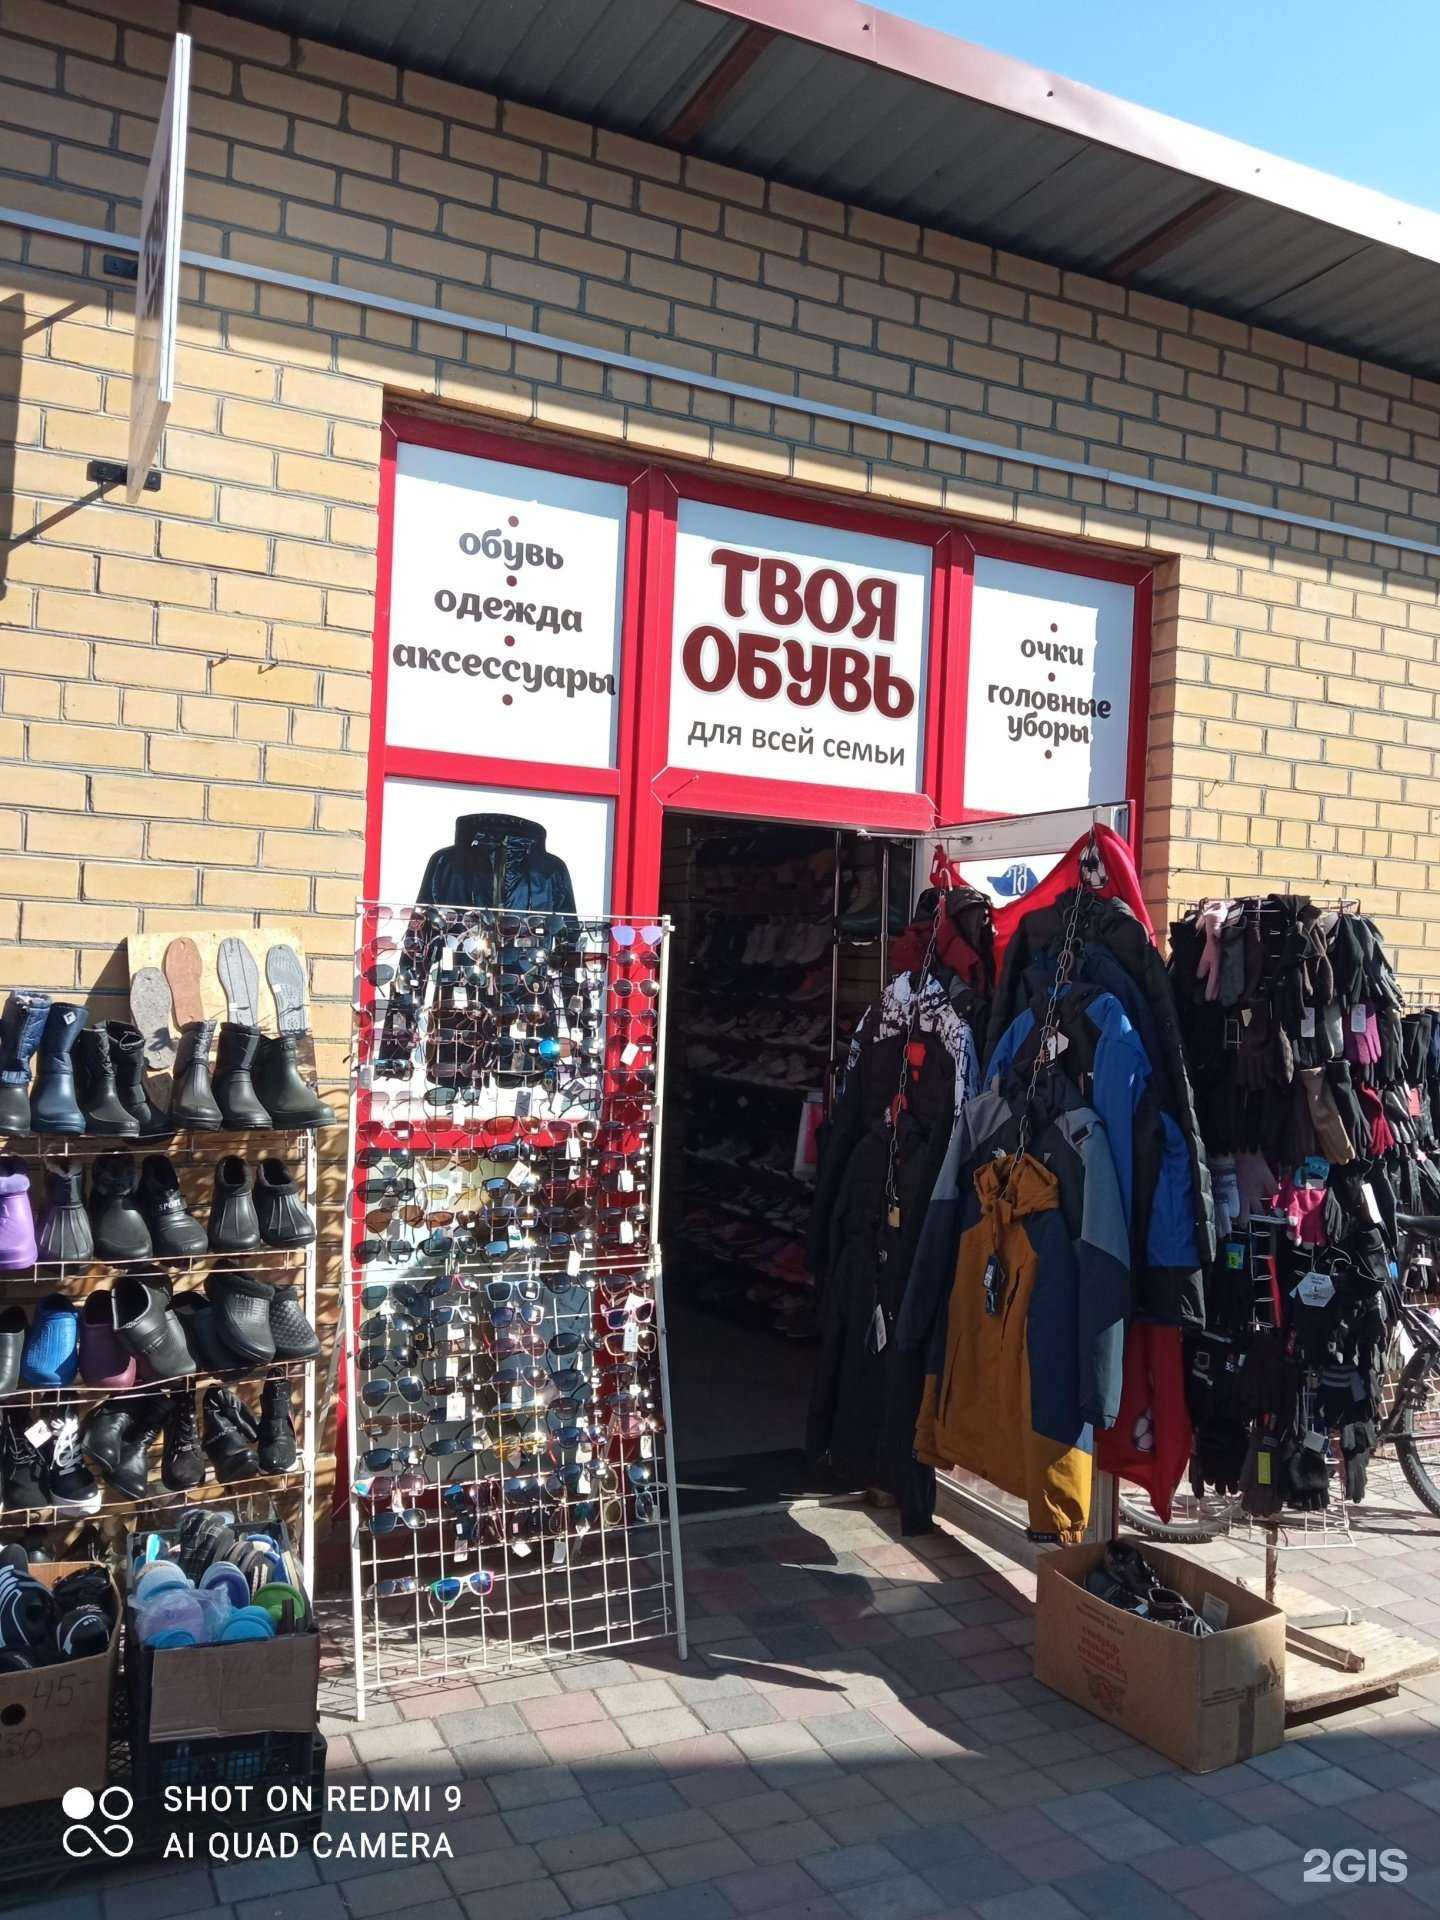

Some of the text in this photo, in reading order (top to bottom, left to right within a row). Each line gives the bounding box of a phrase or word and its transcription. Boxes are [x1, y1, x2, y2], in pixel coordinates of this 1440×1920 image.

[460, 529, 564, 571] обувь
[435, 588, 583, 633] одежда
[711, 548, 898, 643] ТВОЯ
[393, 641, 616, 697] аксессуары
[682, 625, 915, 719] ОБУВЬ
[1020, 639, 1084, 666] очки
[987, 684, 1112, 719] головные
[687, 721, 907, 766] для всей семьи
[1007, 713, 1090, 746] уборы
